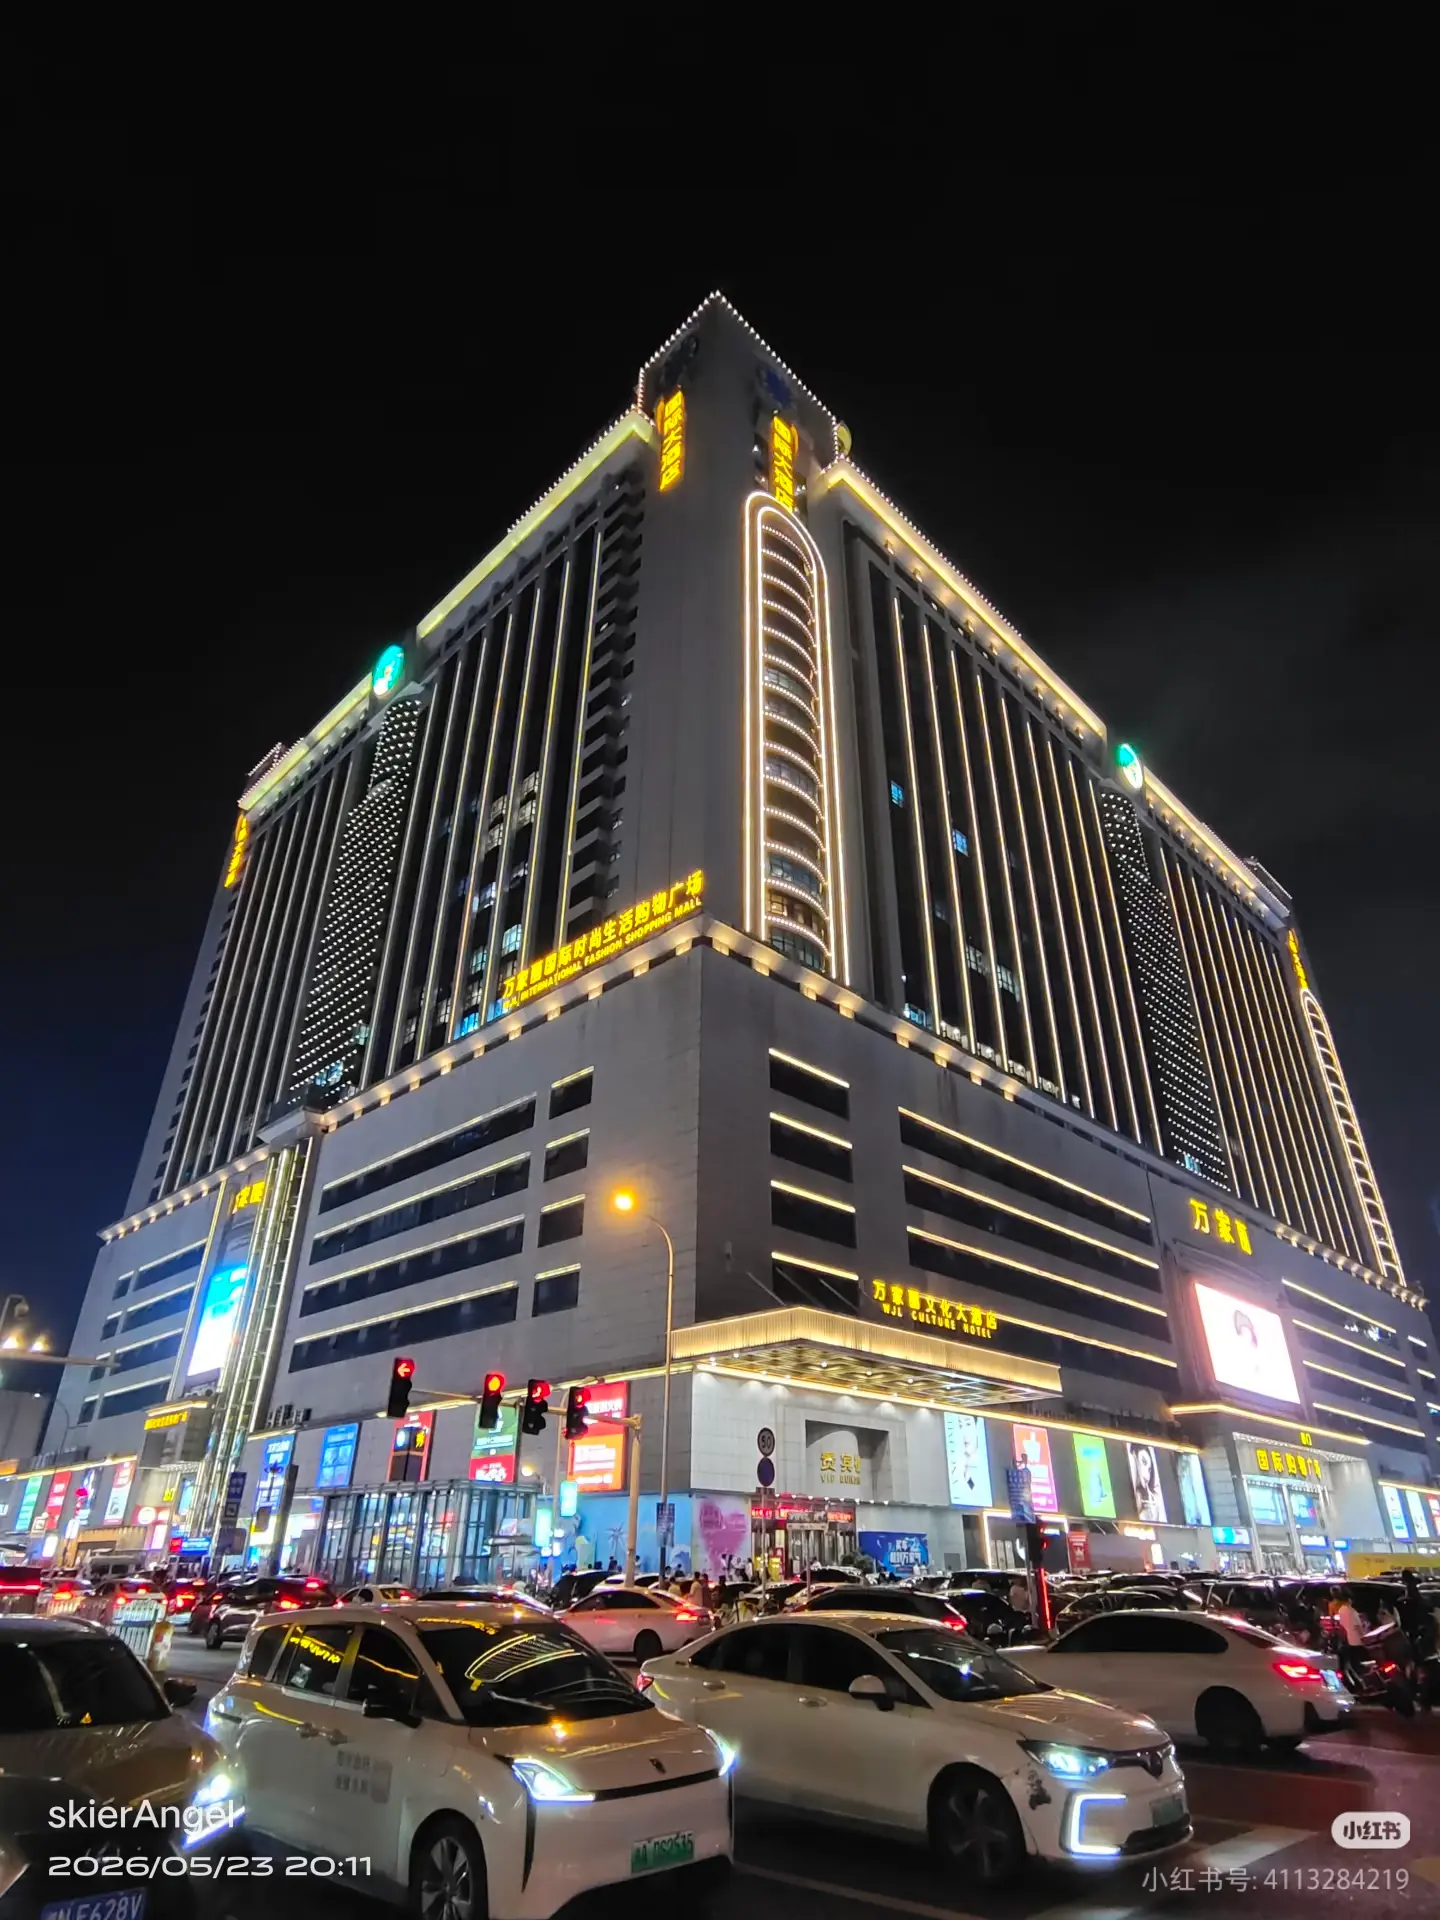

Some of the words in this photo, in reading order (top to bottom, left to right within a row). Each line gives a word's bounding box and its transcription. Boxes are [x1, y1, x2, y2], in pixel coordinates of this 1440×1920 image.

[520, 960, 583, 1002] INTERNATIONAL
[584, 938, 623, 967] FASHION
[625, 911, 672, 945] SHOPPING
[674, 896, 703, 918] MALL
[882, 1302, 903, 1318] WJL
[911, 1310, 956, 1331] CULTURE
[963, 1322, 992, 1339] HOTEL
[820, 1474, 835, 1484] VIP
